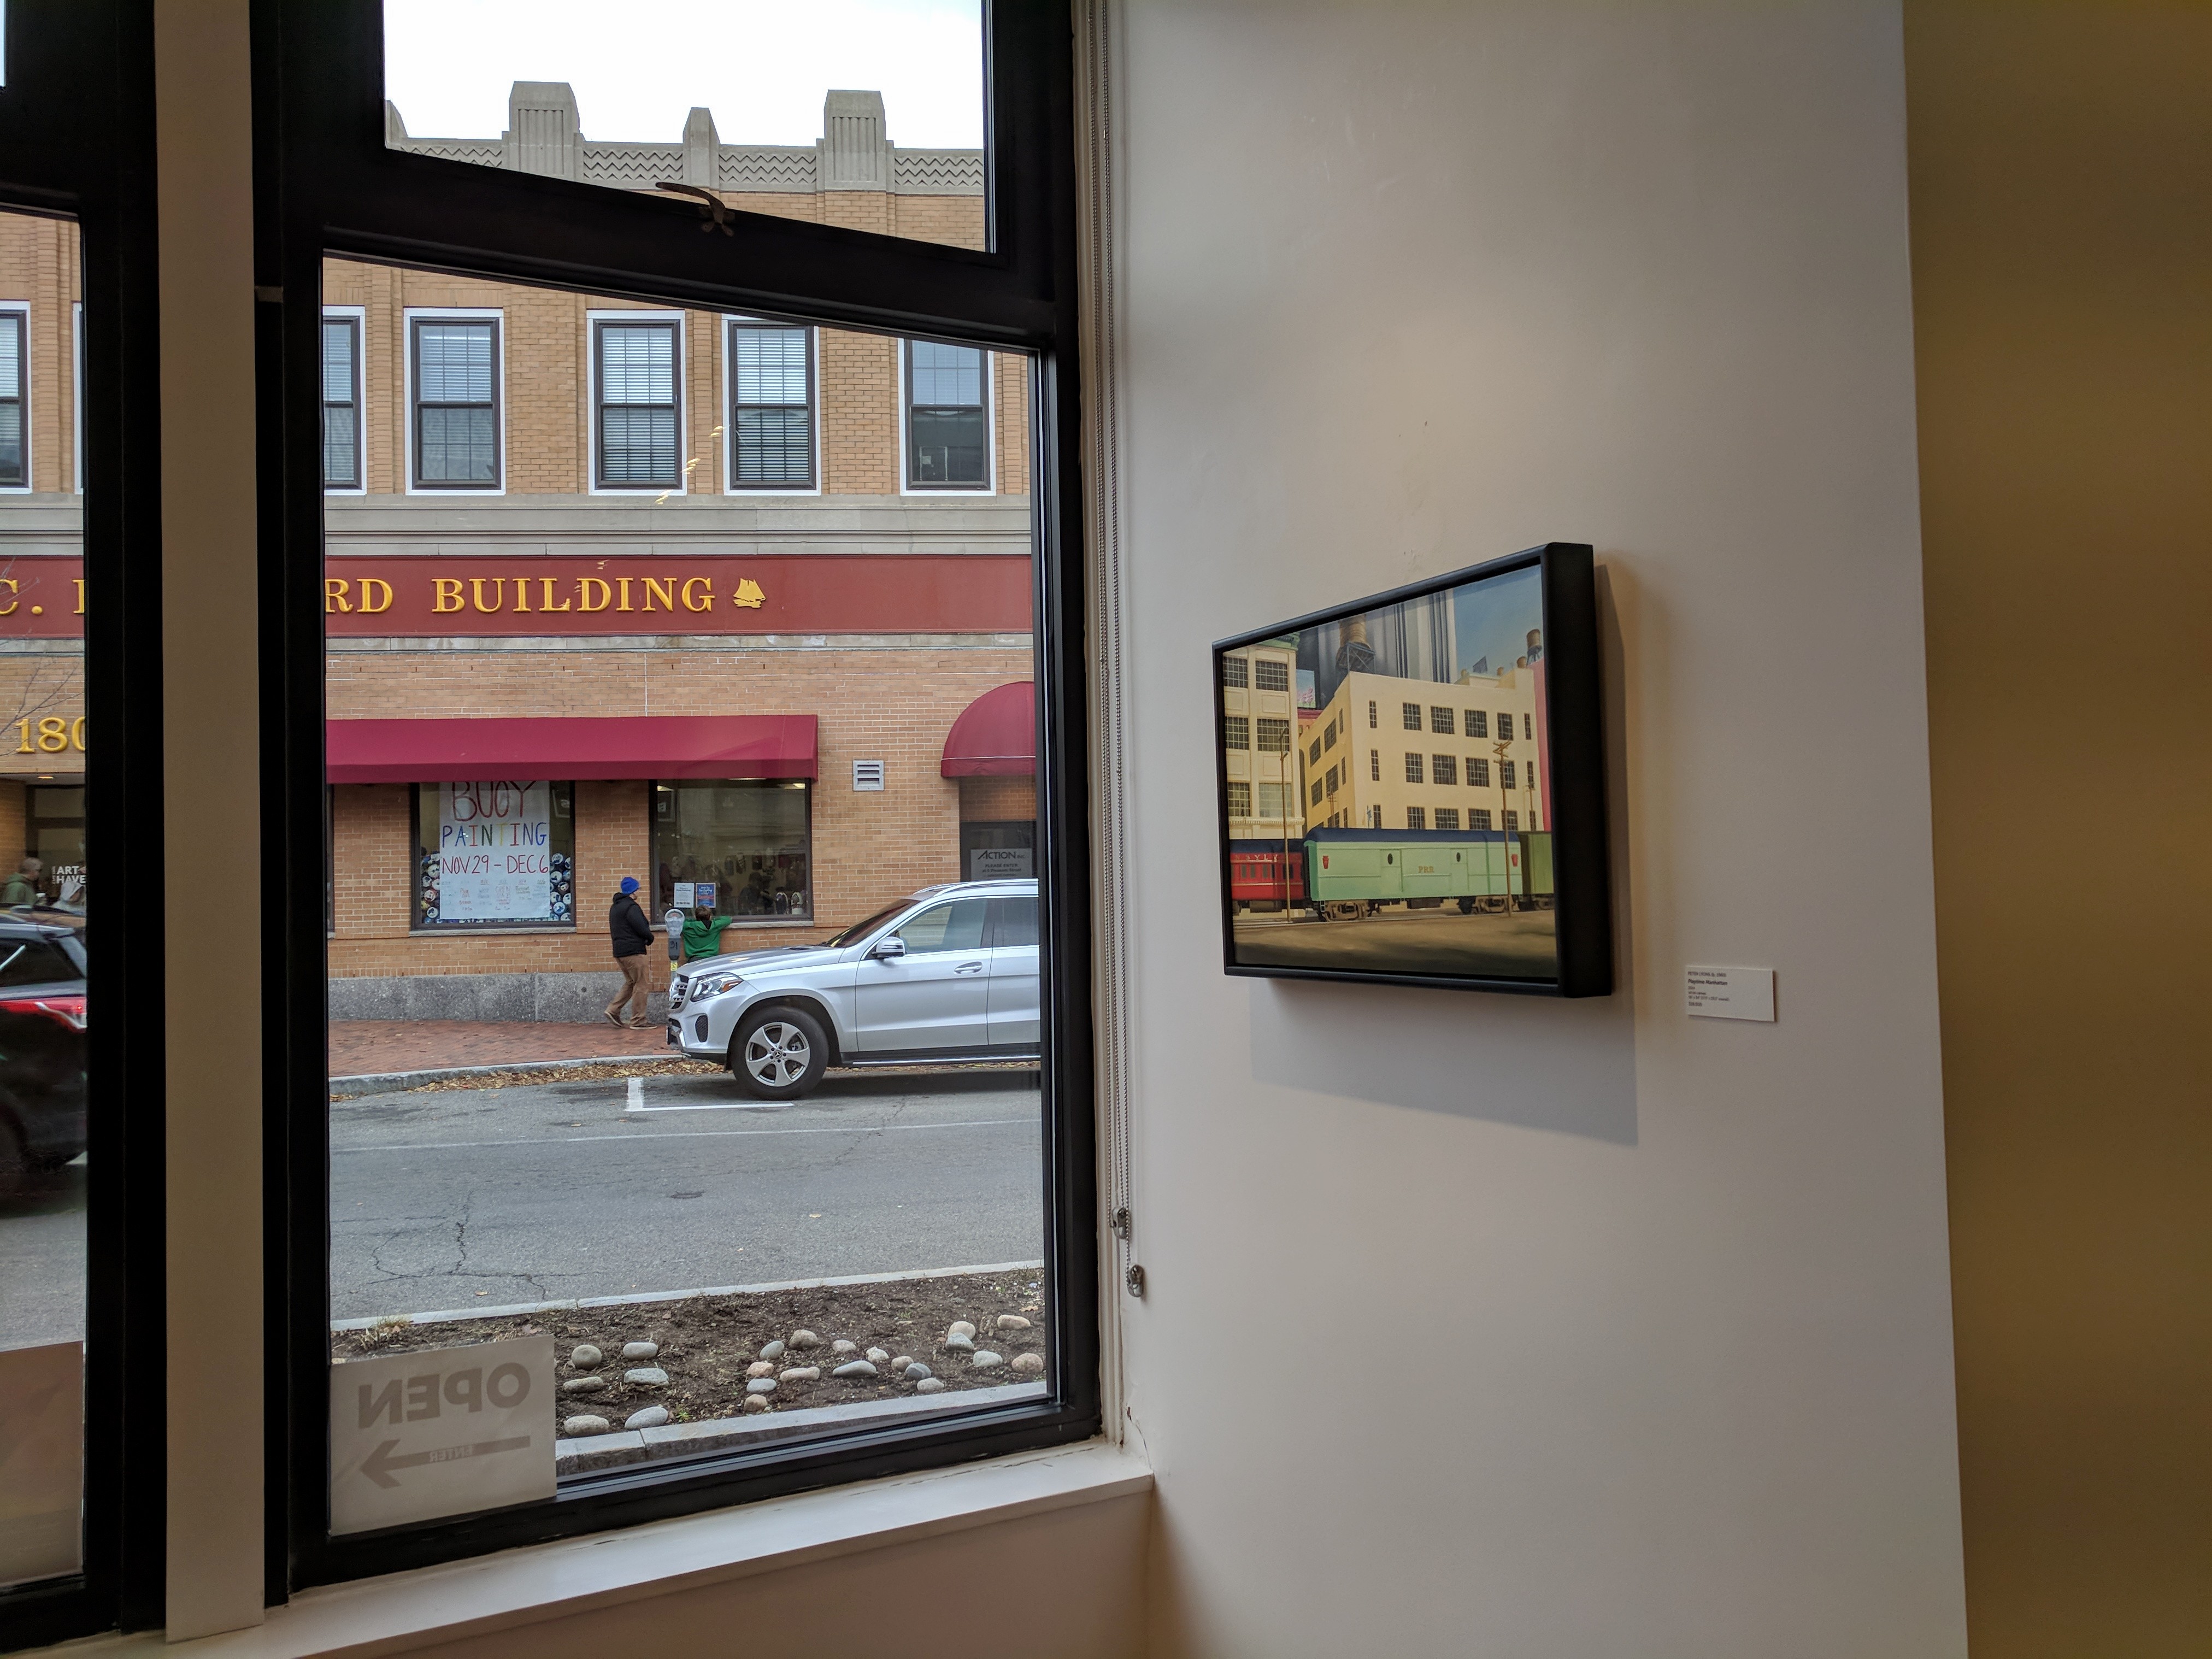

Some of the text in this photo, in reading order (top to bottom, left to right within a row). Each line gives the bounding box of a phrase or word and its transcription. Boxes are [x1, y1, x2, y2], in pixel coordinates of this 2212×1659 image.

[431, 578, 715, 613] BUILDING
[451, 780, 537, 822] BUOY
[442, 822, 547, 848] PAINTING
[507, 854, 535, 874] DEC
[538, 854, 549, 874] 6
[978, 850, 1016, 860] ACTION
[56, 866, 80, 875] ART
